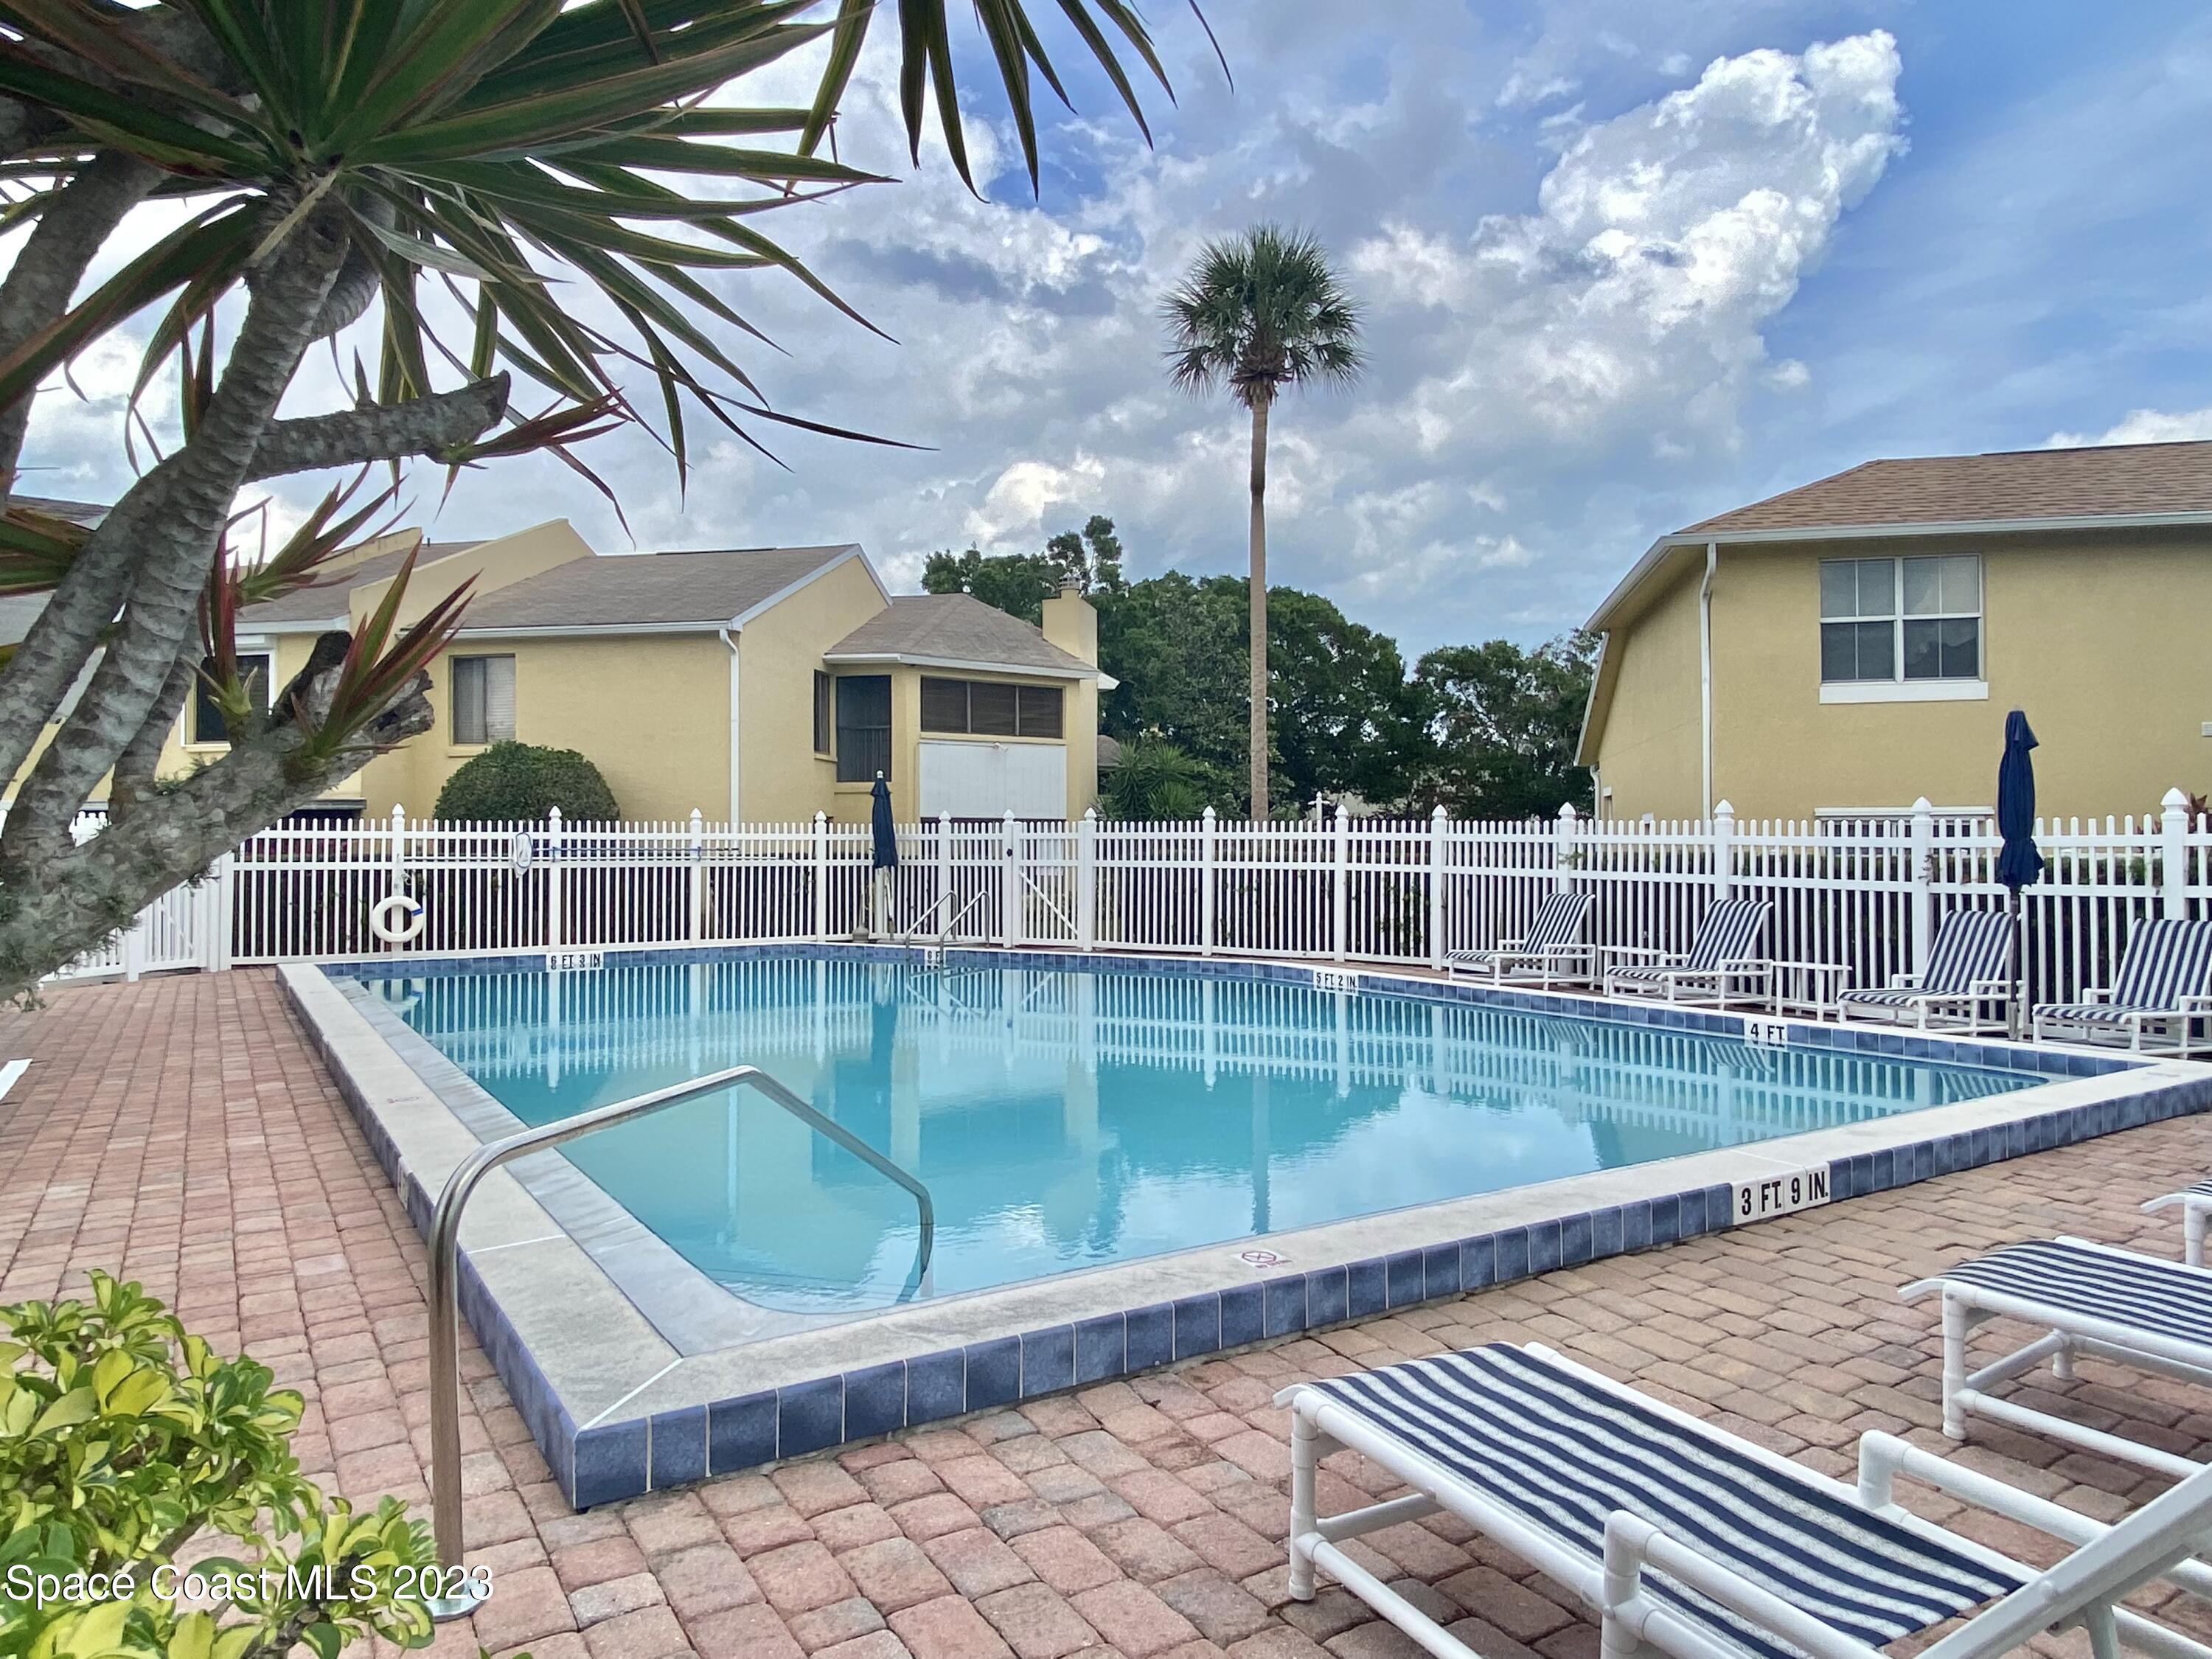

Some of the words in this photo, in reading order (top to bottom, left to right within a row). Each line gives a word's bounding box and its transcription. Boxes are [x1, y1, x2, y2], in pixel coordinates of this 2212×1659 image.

[1316, 973, 1321, 984] 5
[1338, 975, 1343, 986] 2
[1750, 1023, 1759, 1037] 4
[1742, 1187, 1751, 1216] 3
[1761, 1180, 1781, 1212] FT.
[1791, 1177, 1801, 1204] 9
[1809, 1171, 1829, 1200] IN.
